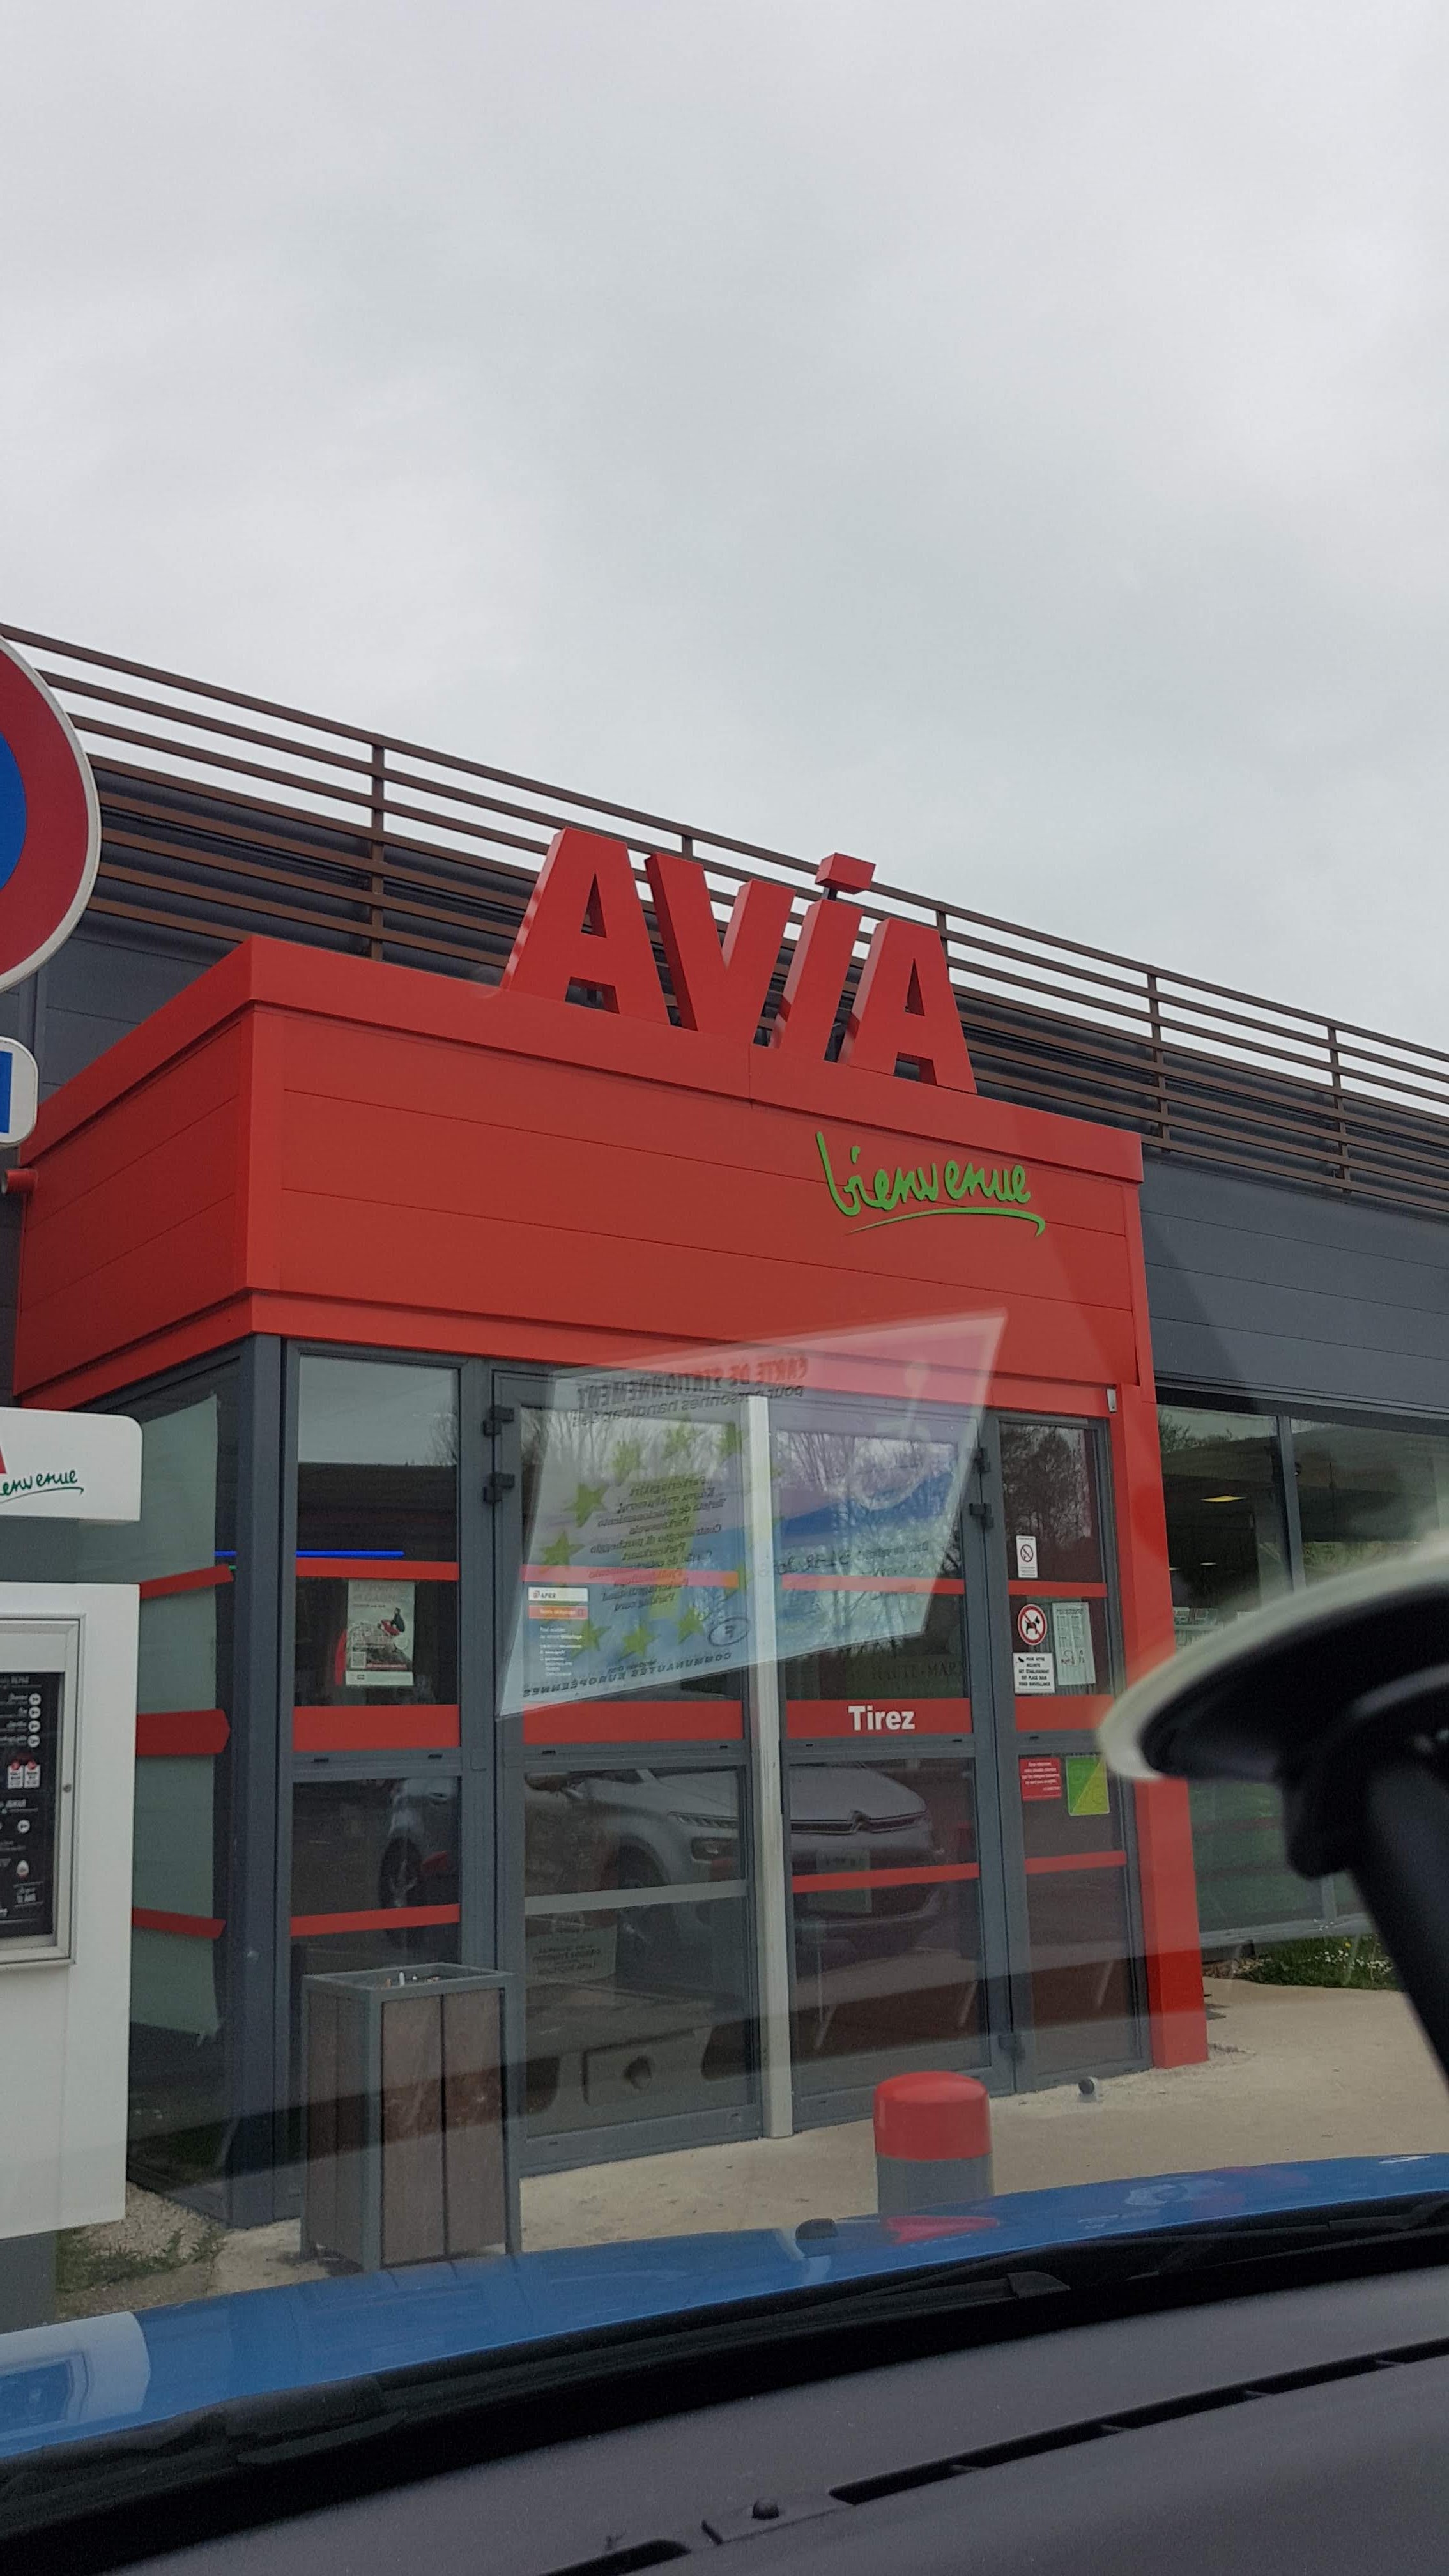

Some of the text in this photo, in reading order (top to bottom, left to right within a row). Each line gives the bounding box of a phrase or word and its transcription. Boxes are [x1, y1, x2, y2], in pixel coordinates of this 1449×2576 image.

[816, 1131, 1031, 1218] bienvenue
[0, 1469, 78, 1496] envenue
[848, 1705, 916, 1731] Tirez
